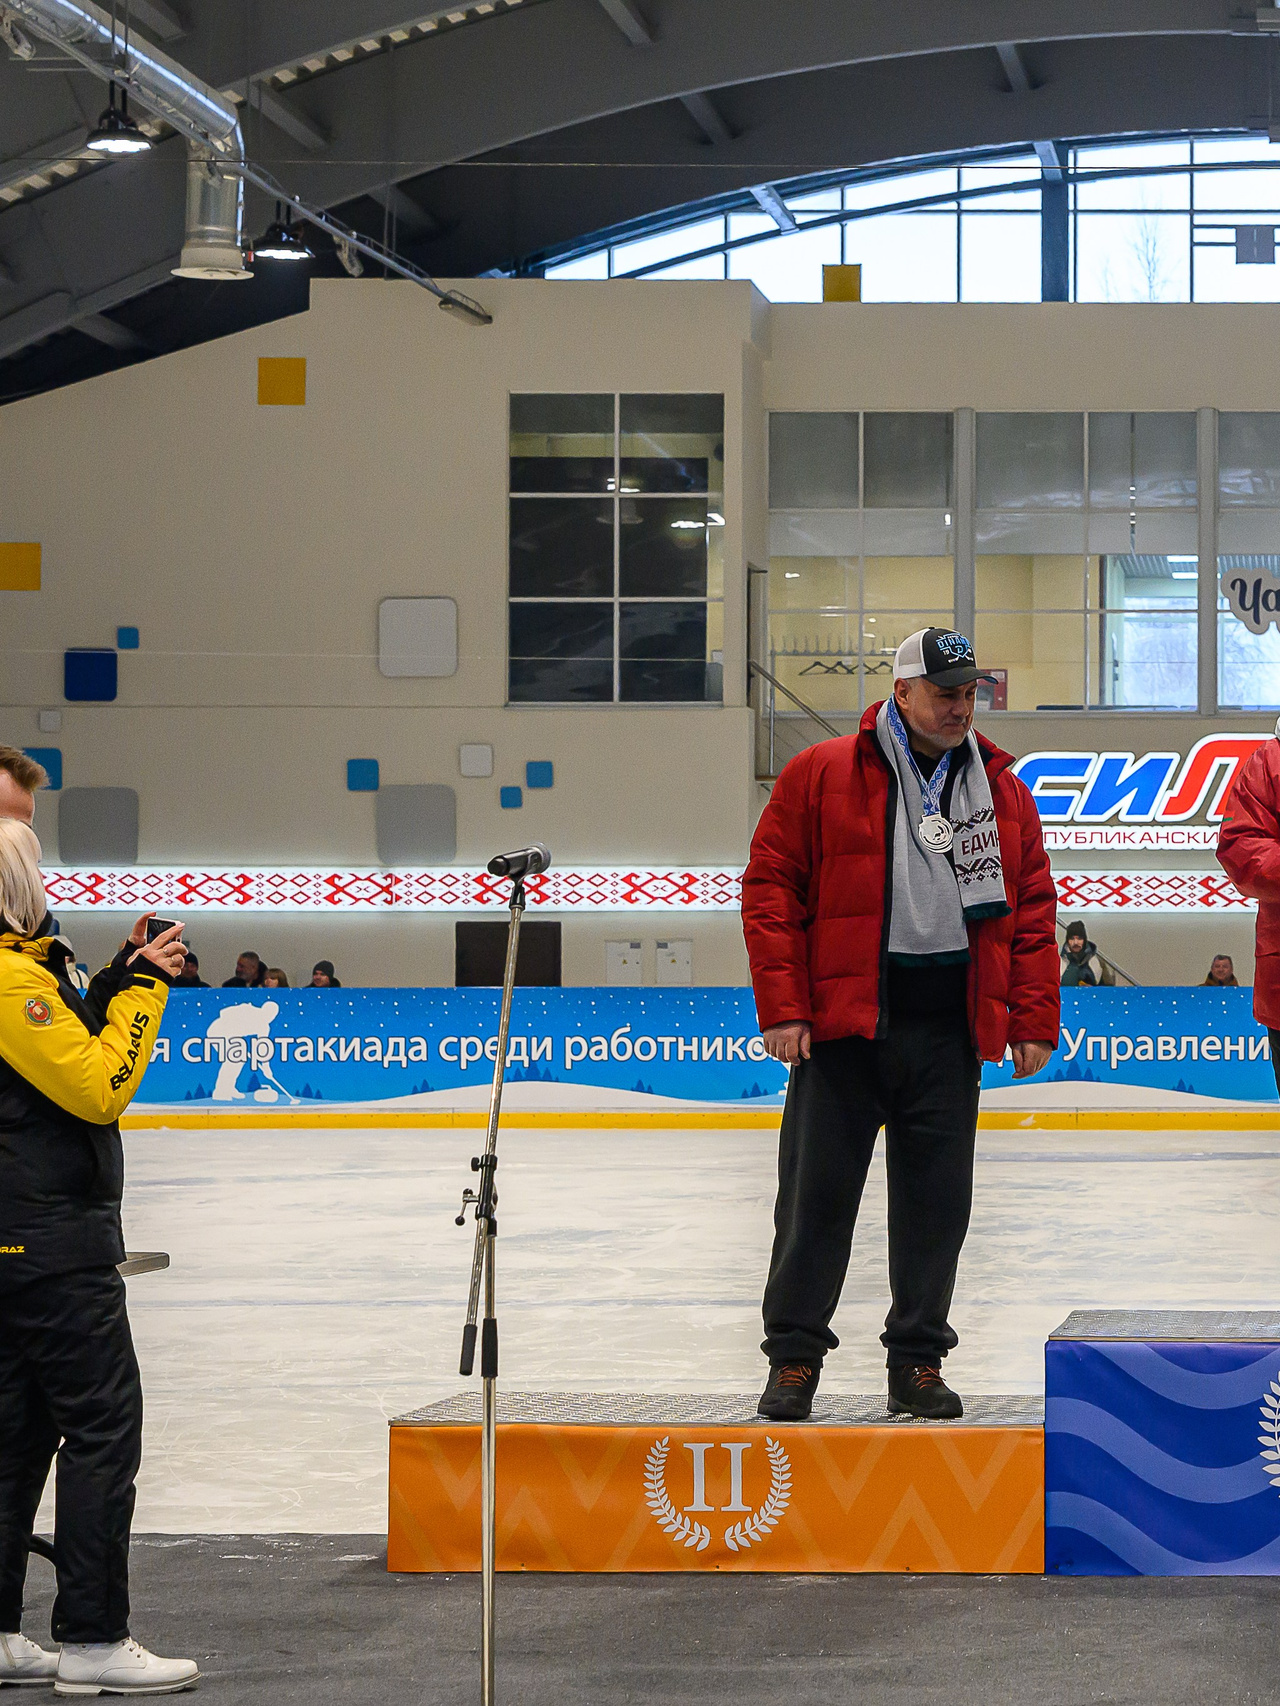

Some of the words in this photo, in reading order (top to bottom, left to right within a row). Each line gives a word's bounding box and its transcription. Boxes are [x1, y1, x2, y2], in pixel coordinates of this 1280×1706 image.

[1011, 735, 1266, 821] СИЛ
[1043, 831, 1219, 844] ПУБЛИКАНСКИ
[109, 1011, 150, 1092] BELARUS
[182, 1036, 427, 1070] спартакиада
[438, 1036, 552, 1070] среди
[564, 1026, 781, 1070] работнико
[1061, 1028, 1272, 1070] Управлени
[0, 1245, 25, 1254] RAZ
[683, 1442, 752, 1512] II
